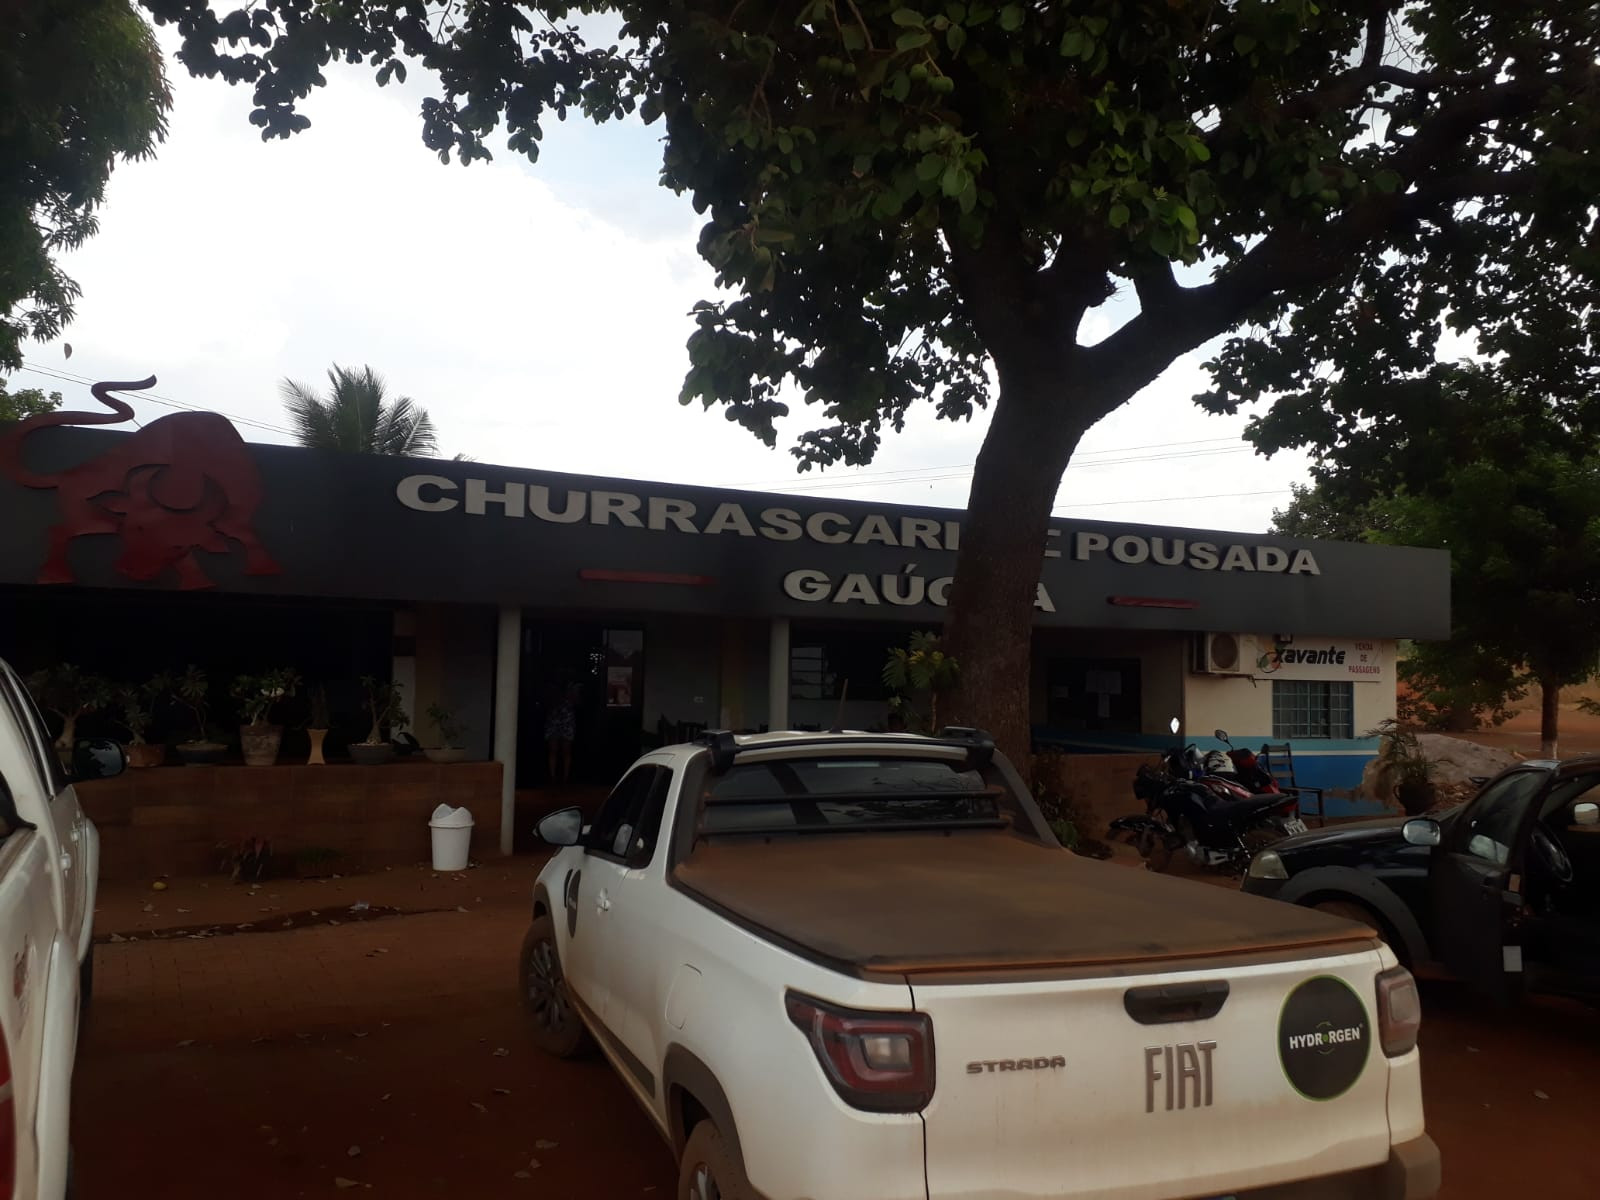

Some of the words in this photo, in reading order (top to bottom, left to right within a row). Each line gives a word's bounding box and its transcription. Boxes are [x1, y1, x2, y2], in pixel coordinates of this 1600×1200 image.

[396, 474, 961, 551] CHURRASCARI
[1075, 531, 1321, 576] POUSADA
[1272, 646, 1346, 665] xavante
[966, 1055, 1066, 1074] STRADA
[1144, 1040, 1217, 1113] FIAT
